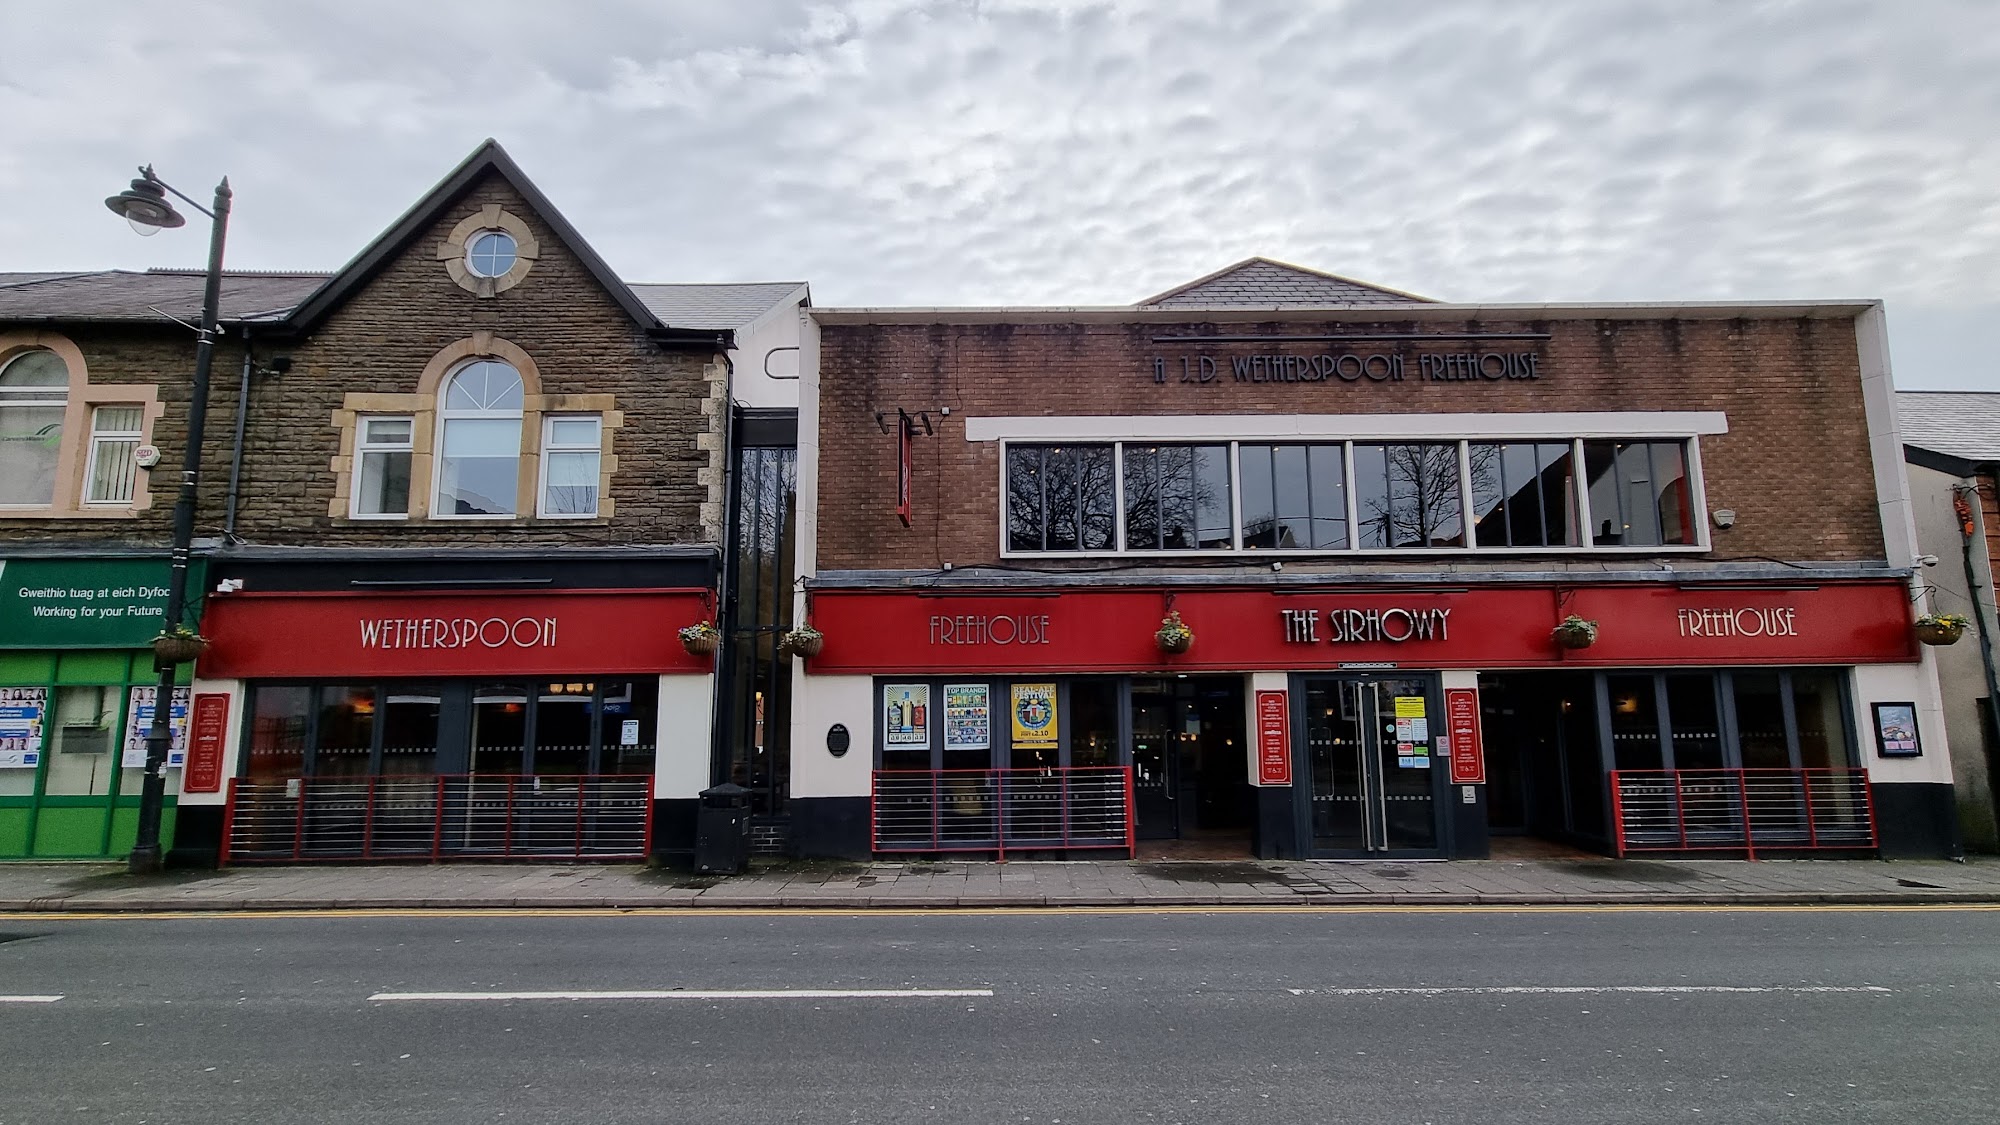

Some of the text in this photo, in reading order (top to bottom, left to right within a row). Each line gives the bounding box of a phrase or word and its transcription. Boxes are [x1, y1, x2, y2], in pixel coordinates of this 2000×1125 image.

[1153, 352, 1540, 382] A J.D. WETHERSPOON FREEHOUSE
[18, 586, 66, 598] Gweithio
[70, 588, 94, 600] tuag
[97, 588, 108, 598] at
[112, 586, 135, 598] eich
[33, 605, 163, 619] Working for your Future
[1281, 607, 1452, 643] THE SIRHOWY
[1677, 607, 1798, 637] FREEHOUSE
[360, 617, 558, 649] WETHERSPOON
[929, 614, 1050, 645] FREEHOUSE
